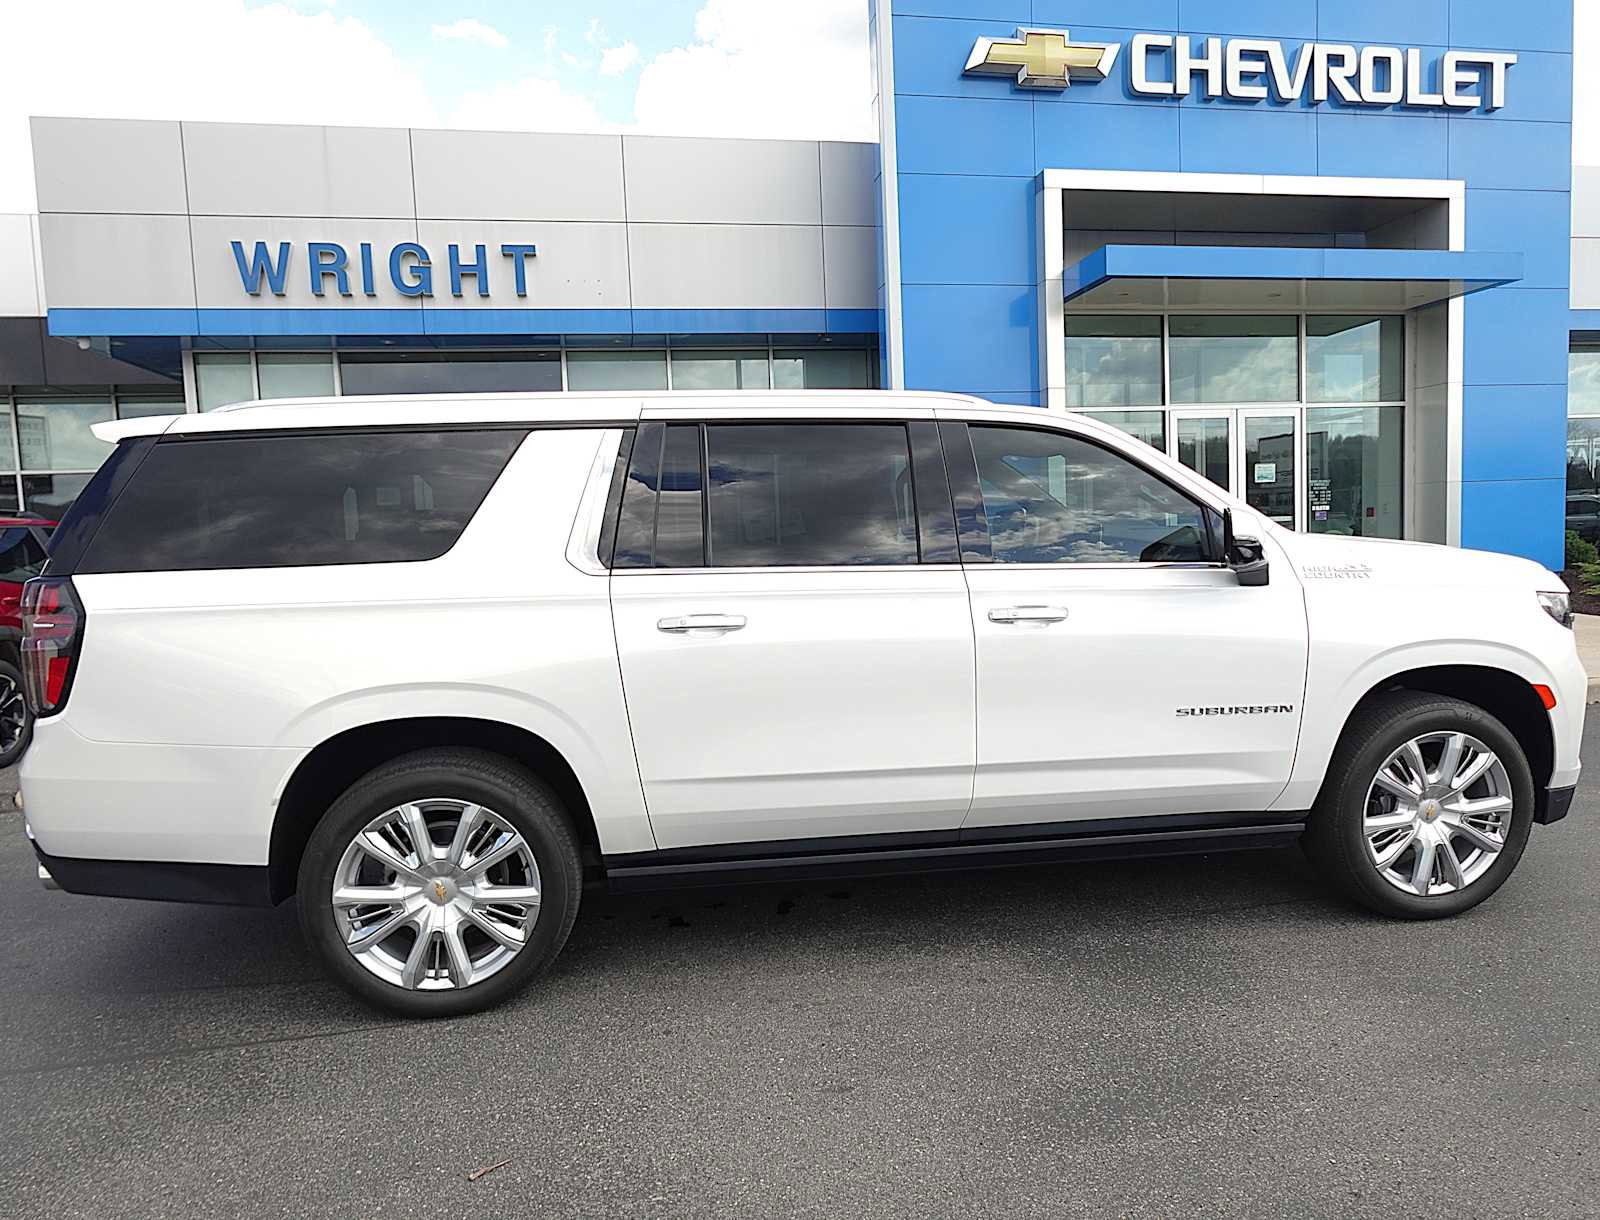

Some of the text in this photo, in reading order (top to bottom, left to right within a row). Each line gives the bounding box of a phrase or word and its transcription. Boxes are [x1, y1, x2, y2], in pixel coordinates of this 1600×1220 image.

[1129, 33, 1518, 111] CHEVROLET
[230, 241, 537, 297] WRIGHT
[1176, 705, 1293, 716] SUBURBAN
